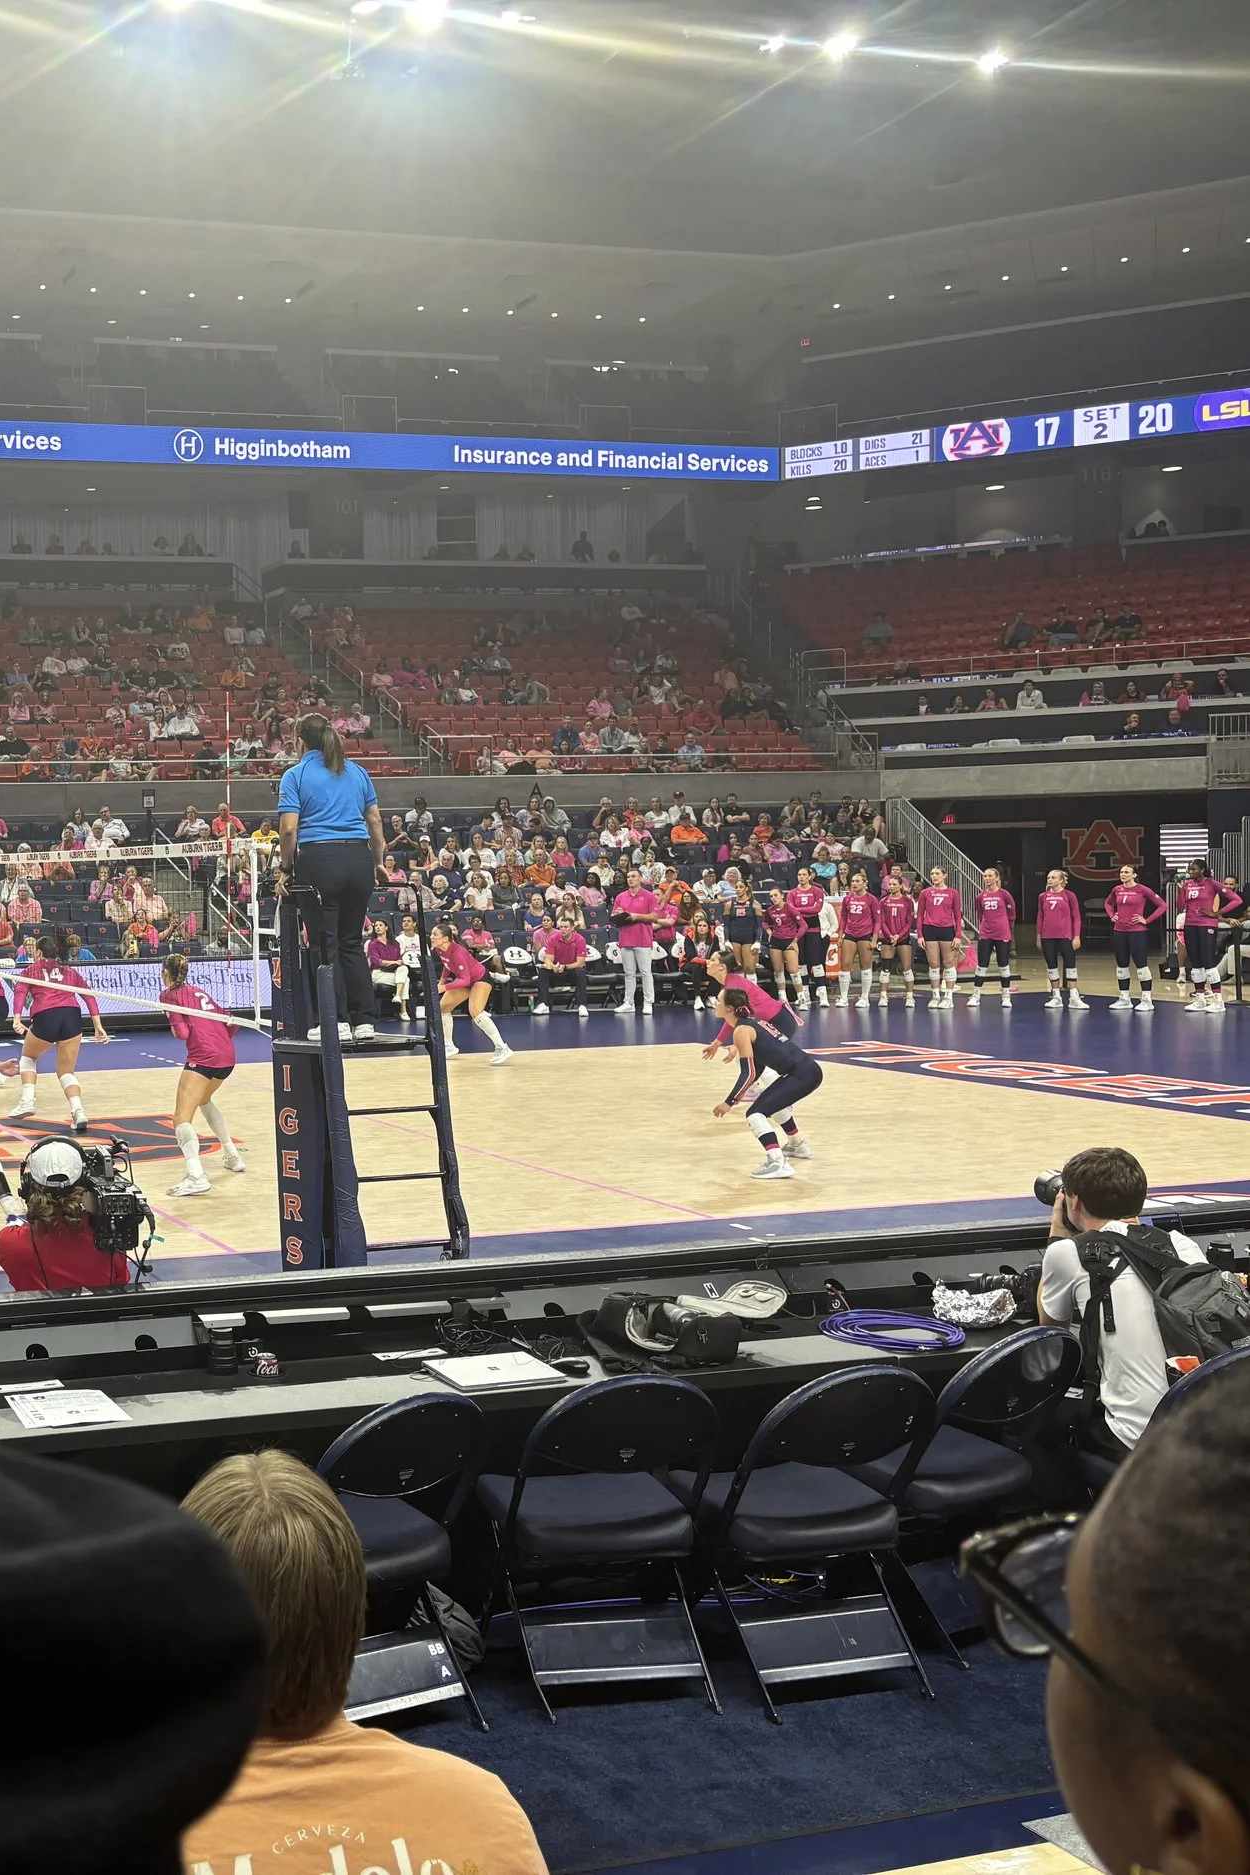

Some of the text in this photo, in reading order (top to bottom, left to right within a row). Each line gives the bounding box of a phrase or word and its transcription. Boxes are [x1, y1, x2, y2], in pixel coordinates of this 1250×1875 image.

[1082, 407, 1120, 422] SET
[1139, 403, 1173, 434] 20
[1035, 417, 1060, 446] 17
[1094, 423, 1108, 439] 2
[215, 437, 350, 460] Higginbotham
[865, 432, 923, 450] DIGS 21
[454, 445, 768, 473] Insurance and Financial Services
[790, 443, 847, 460] BLOCKS 1.0
[865, 450, 919, 467] ACES 1
[790, 459, 847, 476] KILLS 20
[530, 782, 542, 798] A
[933, 896, 945, 906] 17
[1188, 890, 1199, 899] 19
[851, 905, 863, 914] 22
[984, 901, 998, 910] 25
[1049, 901, 1057, 910] 7
[43, 967, 64, 982] 14
[89, 971, 123, 989] dical
[195, 992, 215, 1011] 2
[427, 1642, 445, 1656] BB
[441, 1665, 452, 1677] A
[272, 1823, 366, 1856] CERVEZA
